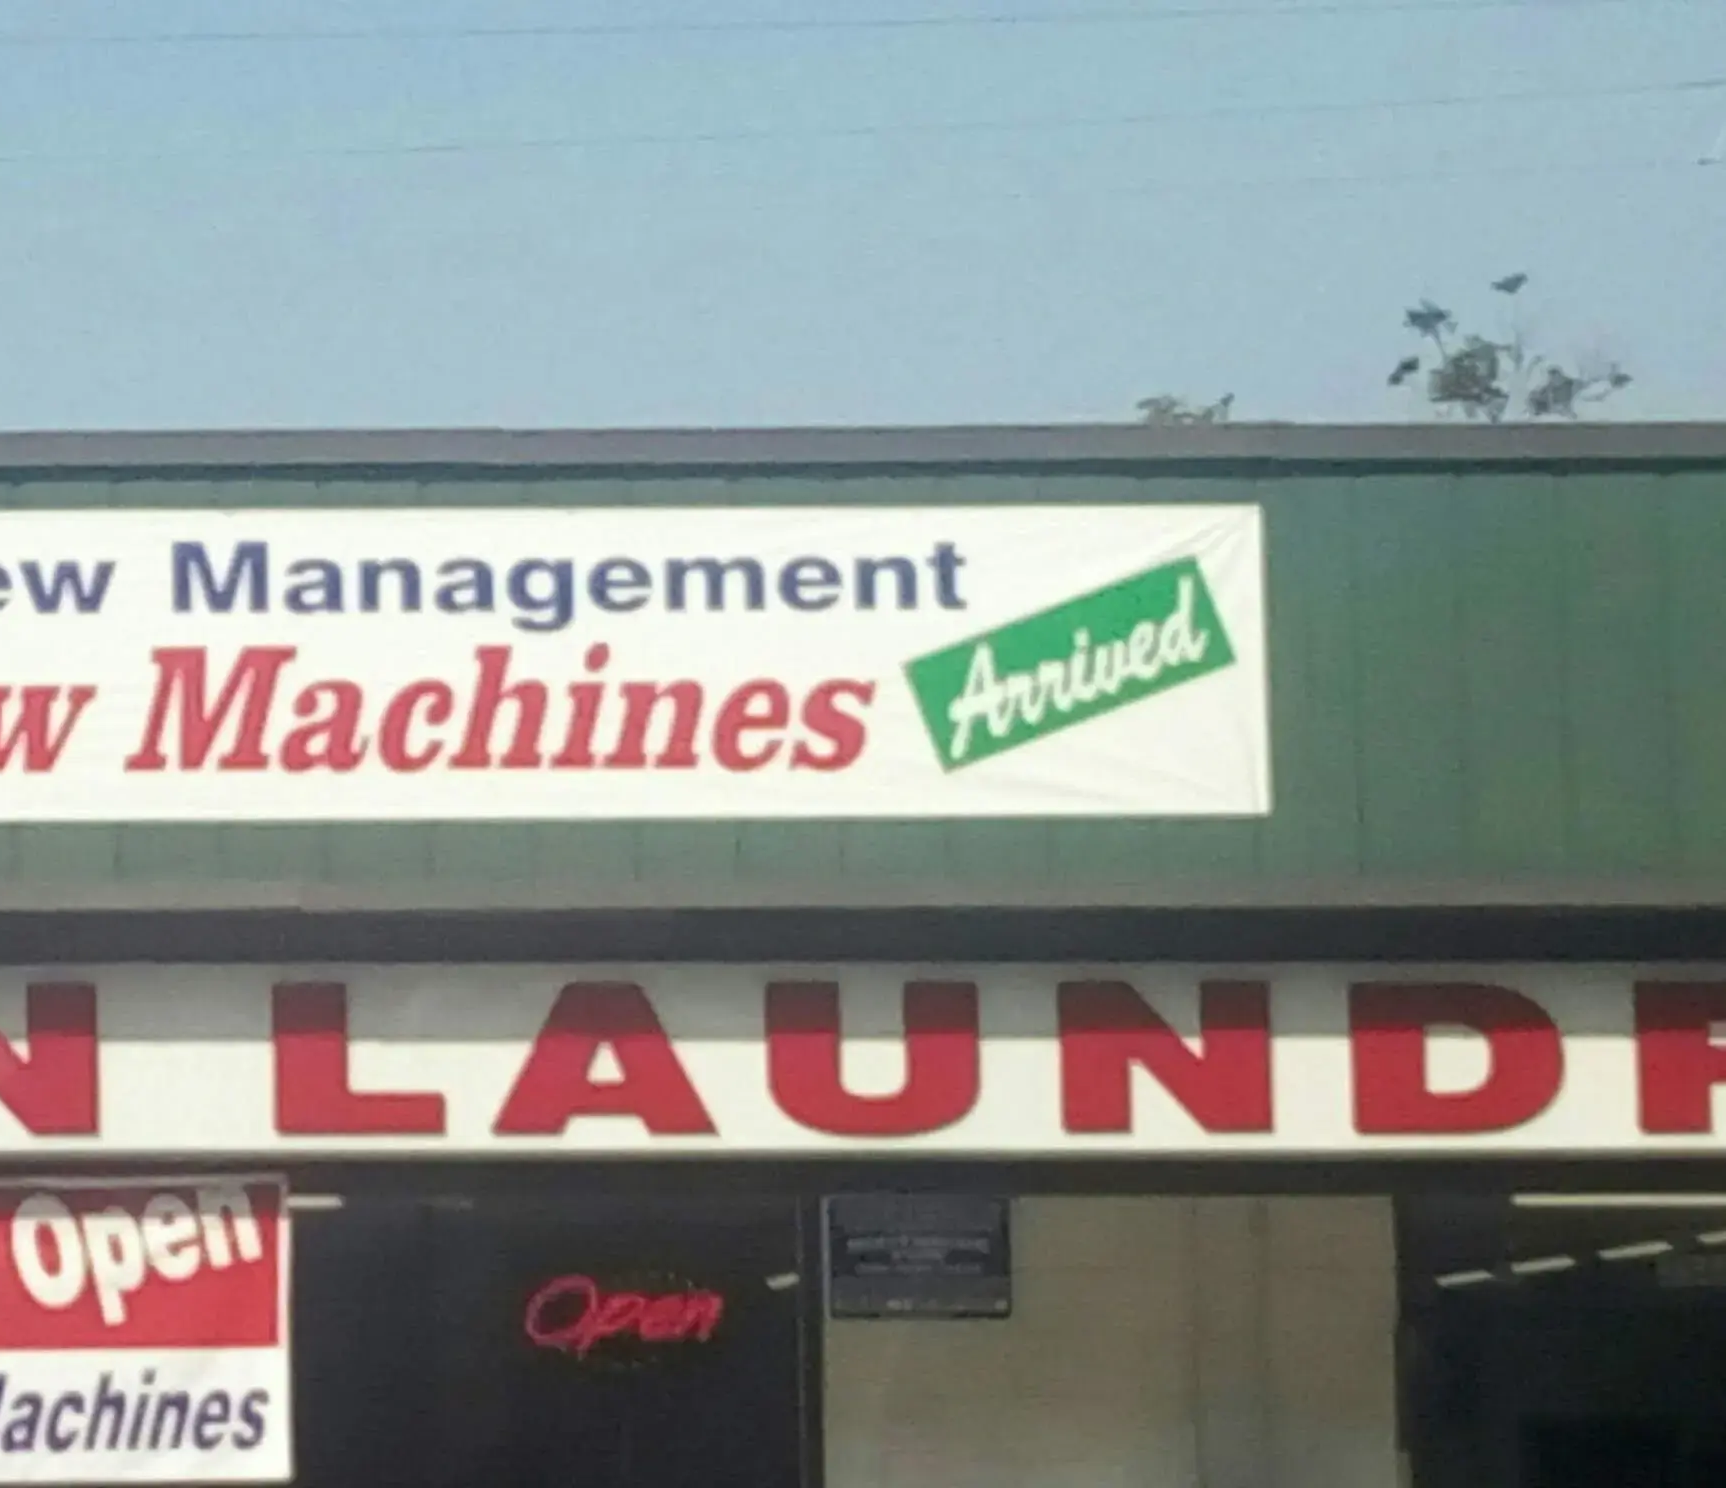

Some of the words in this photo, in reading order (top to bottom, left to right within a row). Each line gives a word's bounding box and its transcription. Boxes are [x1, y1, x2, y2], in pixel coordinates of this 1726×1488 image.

[170, 540, 967, 632] Management
[125, 643, 876, 773] Machines
[946, 576, 1207, 759] Arrived
[11, 1184, 263, 1326] Open
[524, 1273, 724, 1359] Open
